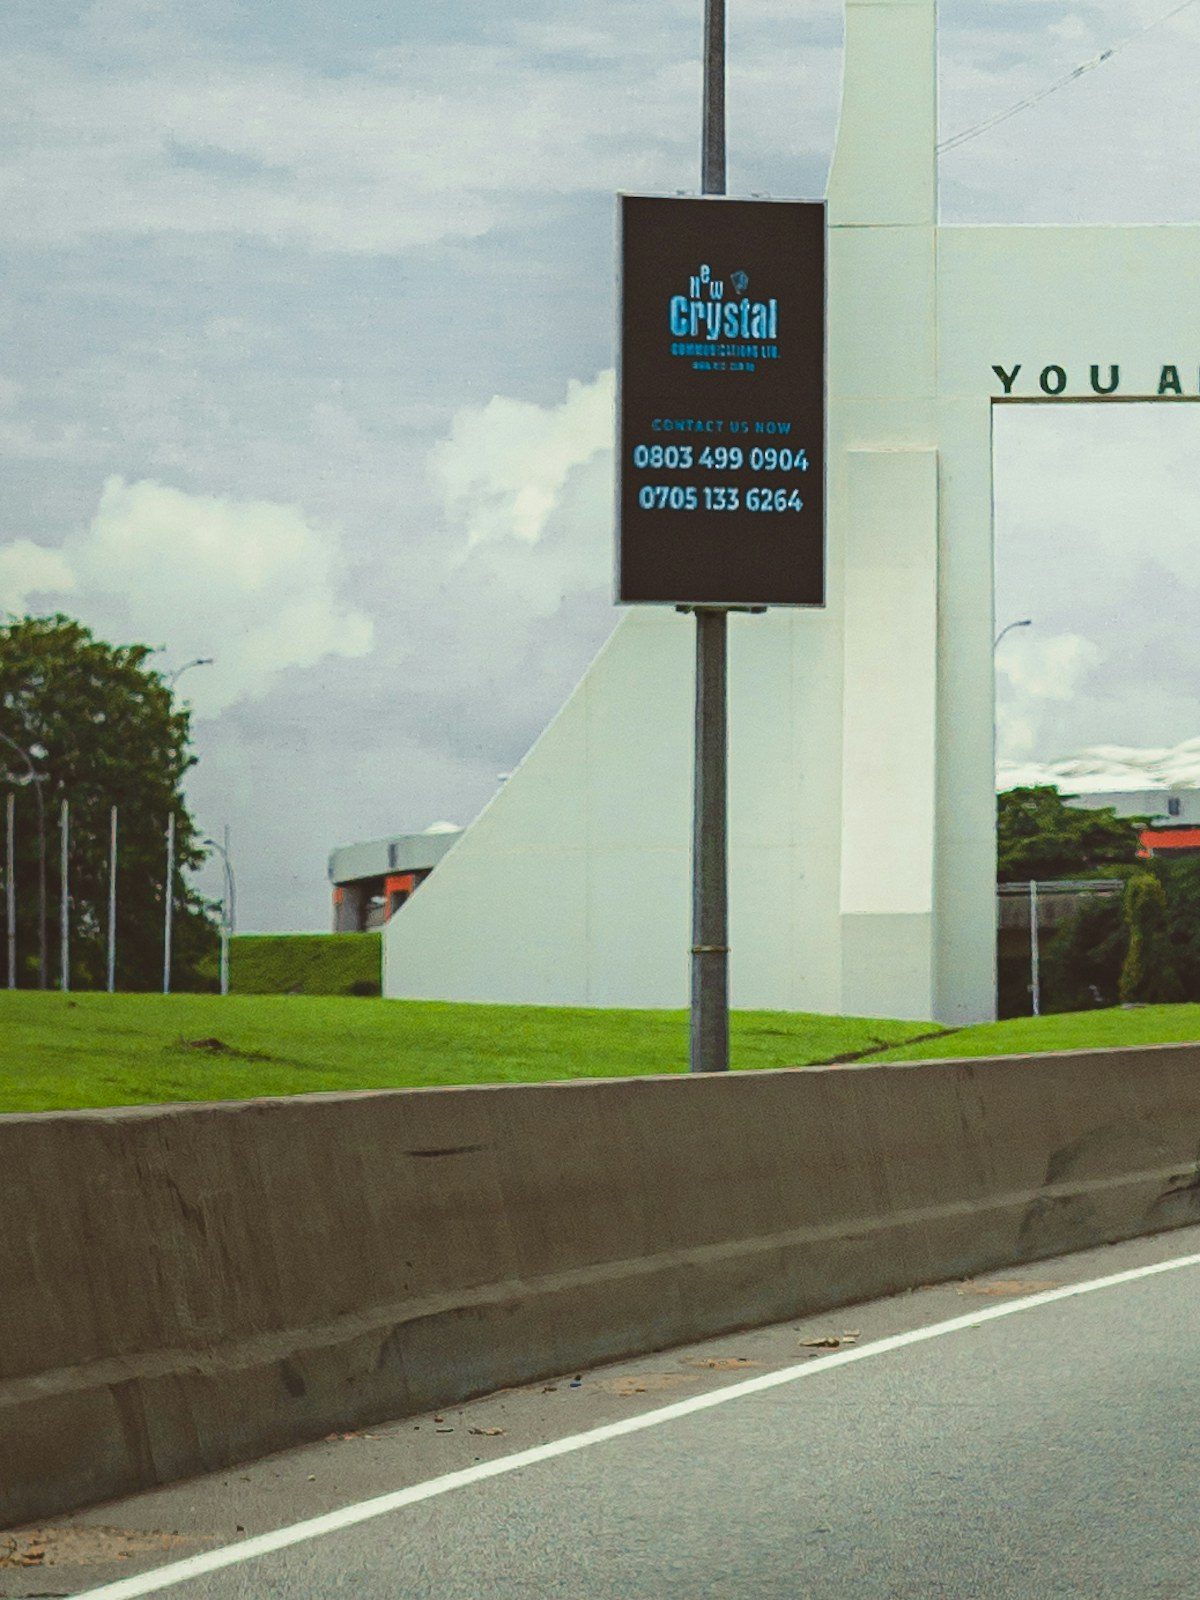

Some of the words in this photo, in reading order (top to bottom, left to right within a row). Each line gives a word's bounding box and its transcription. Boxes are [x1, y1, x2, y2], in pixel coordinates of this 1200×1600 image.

[670, 295, 778, 341] Crystal
[991, 364, 1120, 395] YOU
[651, 418, 724, 433] CONTACT
[729, 420, 749, 434] US
[754, 421, 792, 435] NOW
[634, 444, 693, 469] 0803
[698, 446, 744, 470] 499
[750, 448, 809, 472] 0904
[639, 485, 698, 510] 0705
[703, 486, 740, 511] 133
[746, 487, 804, 512] 6264
